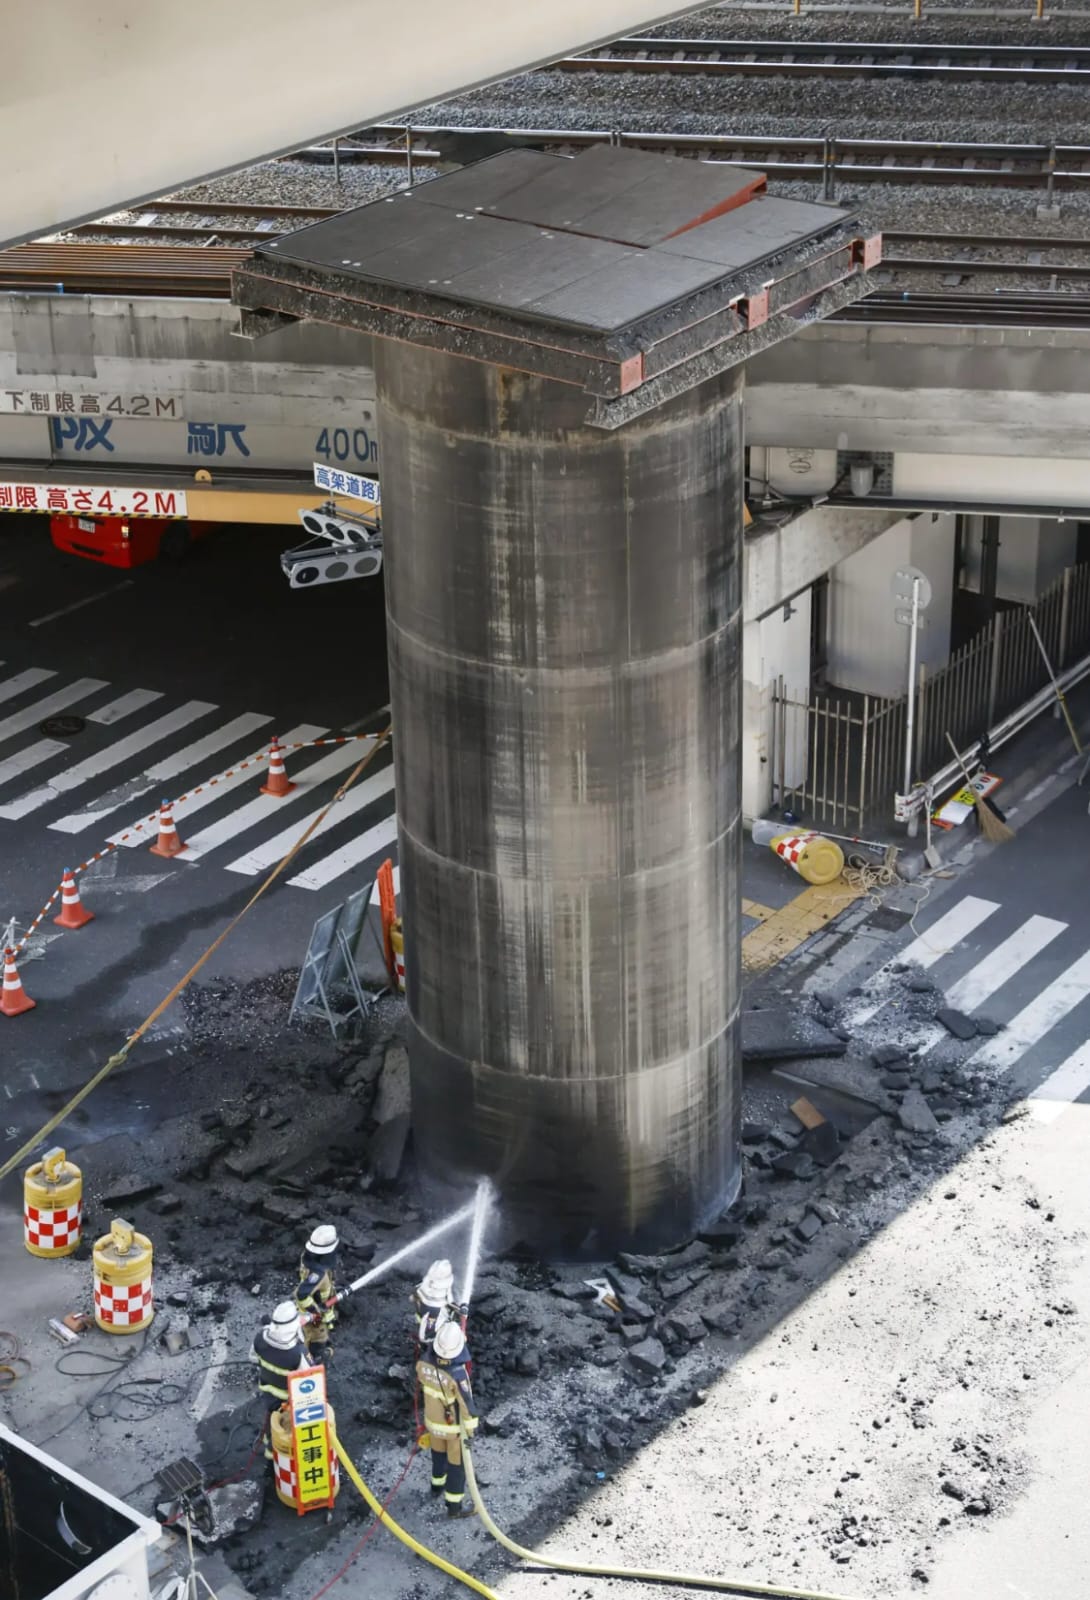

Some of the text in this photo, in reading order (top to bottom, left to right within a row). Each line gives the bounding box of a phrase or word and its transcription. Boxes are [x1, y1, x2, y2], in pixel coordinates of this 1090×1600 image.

[316, 467, 380, 503] 高架道路
[301, 1424, 324, 1484] 工事中
